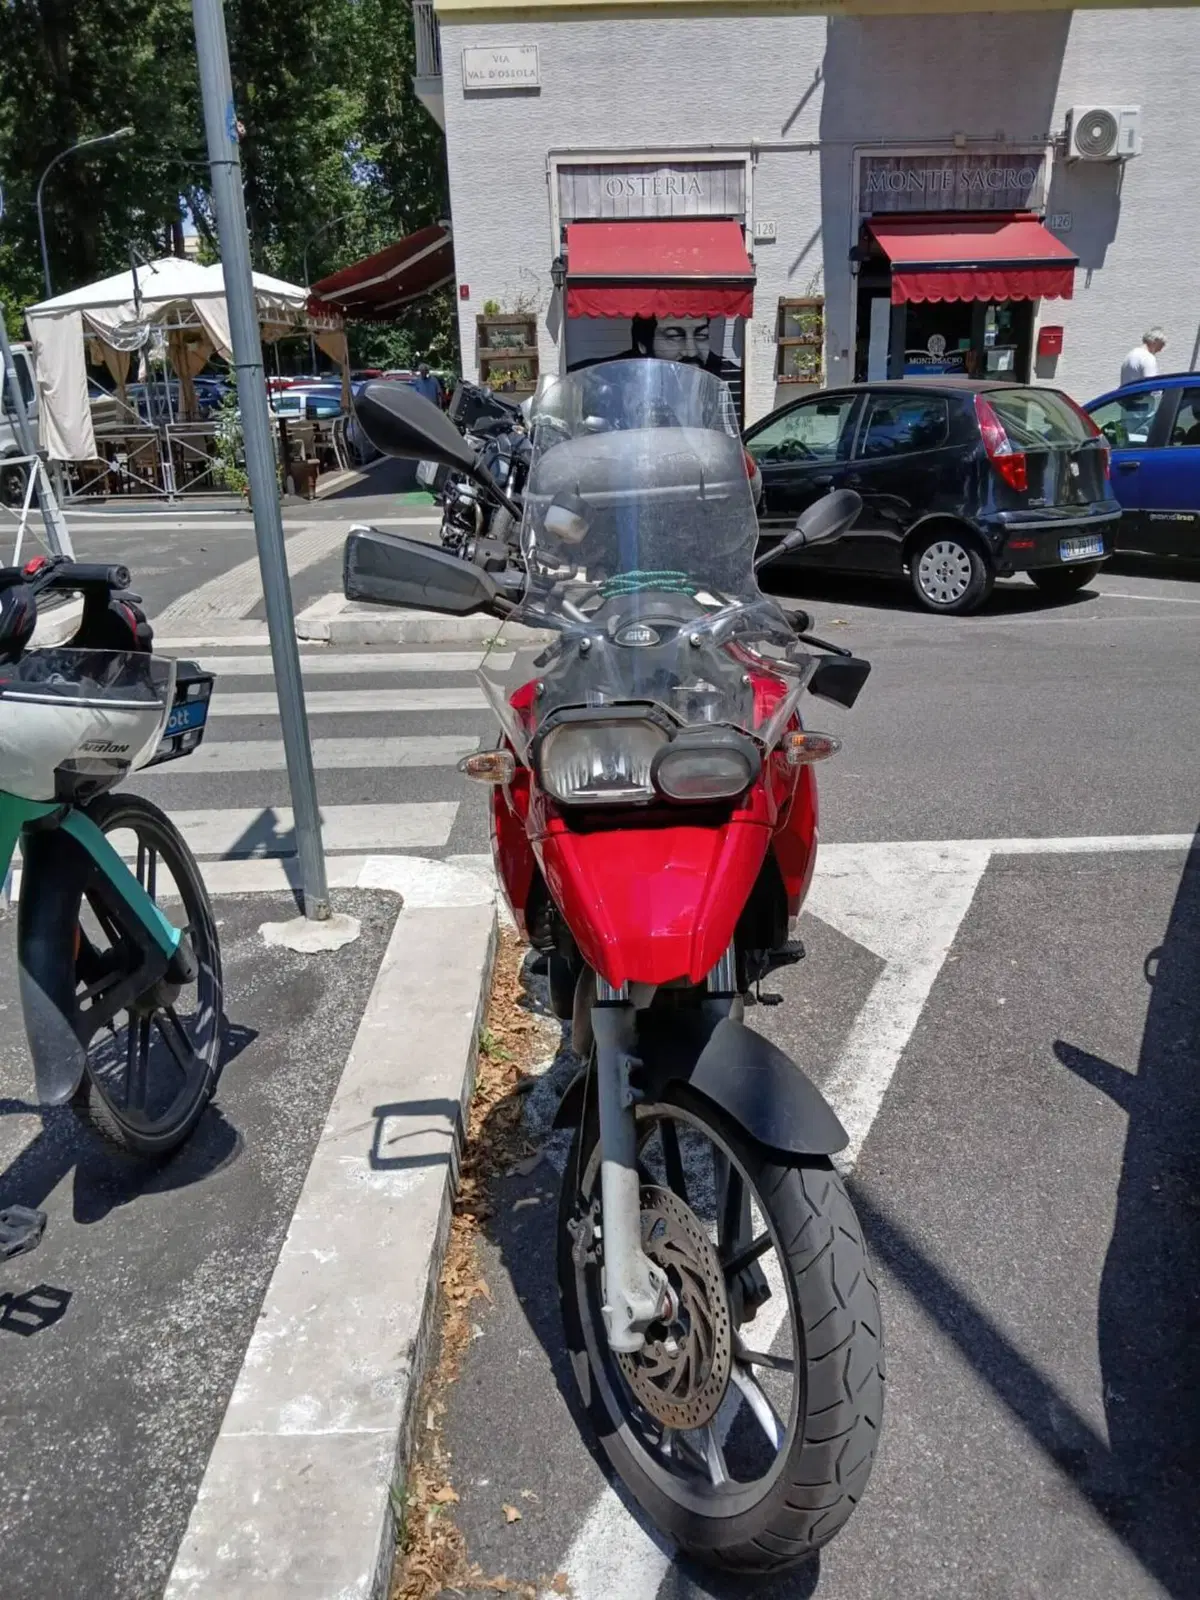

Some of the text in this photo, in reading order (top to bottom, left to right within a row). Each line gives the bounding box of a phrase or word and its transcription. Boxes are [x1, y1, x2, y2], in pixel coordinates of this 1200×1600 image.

[491, 54, 511, 64] VIA
[467, 70, 487, 80] VAL
[606, 175, 703, 197] OSTERIA
[866, 167, 1038, 192] MONTE SACRO
[757, 221, 775, 235] 128
[1053, 215, 1071, 229] 126
